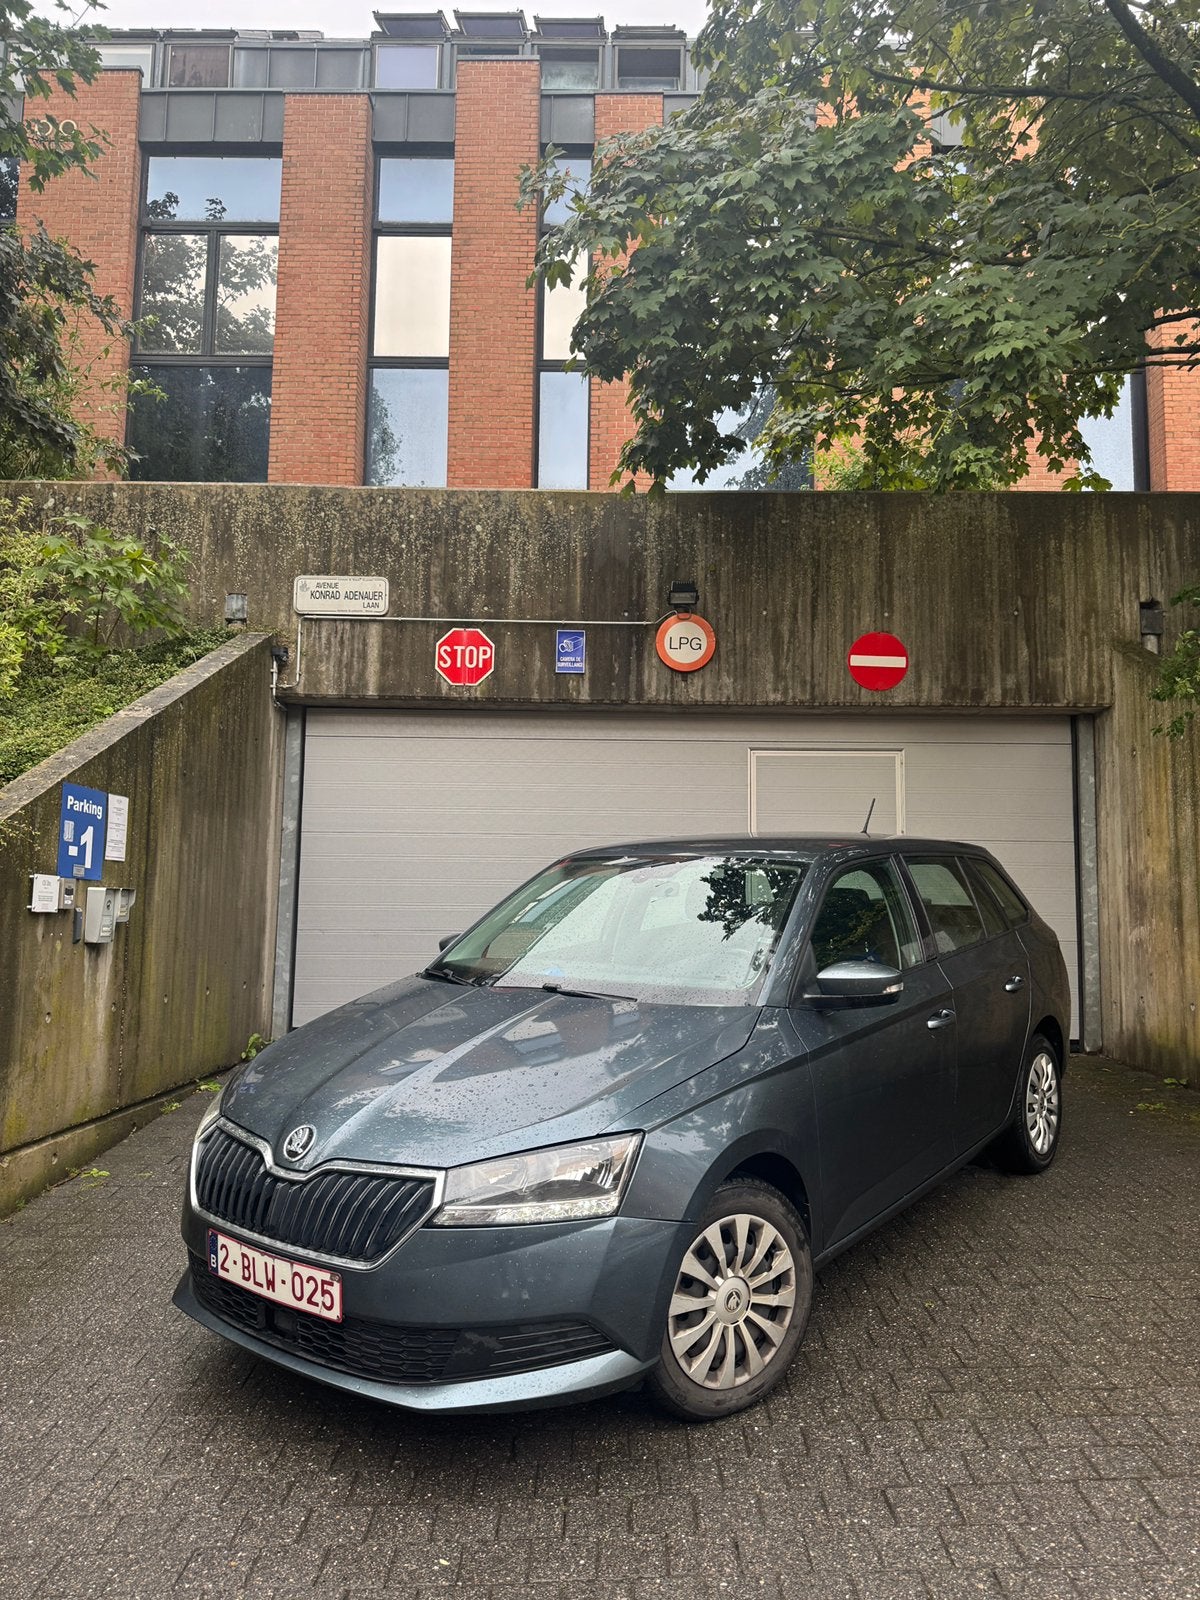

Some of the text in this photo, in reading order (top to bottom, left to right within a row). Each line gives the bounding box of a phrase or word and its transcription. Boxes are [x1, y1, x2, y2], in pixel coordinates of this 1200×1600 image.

[310, 591, 383, 600] KONRAD ADENAUER
[669, 637, 702, 651] LPG
[439, 645, 491, 668] STOP
[67, 795, 103, 820] Parking
[68, 825, 94, 869] -1
[210, 1243, 335, 1311] B 2-BLW-025
